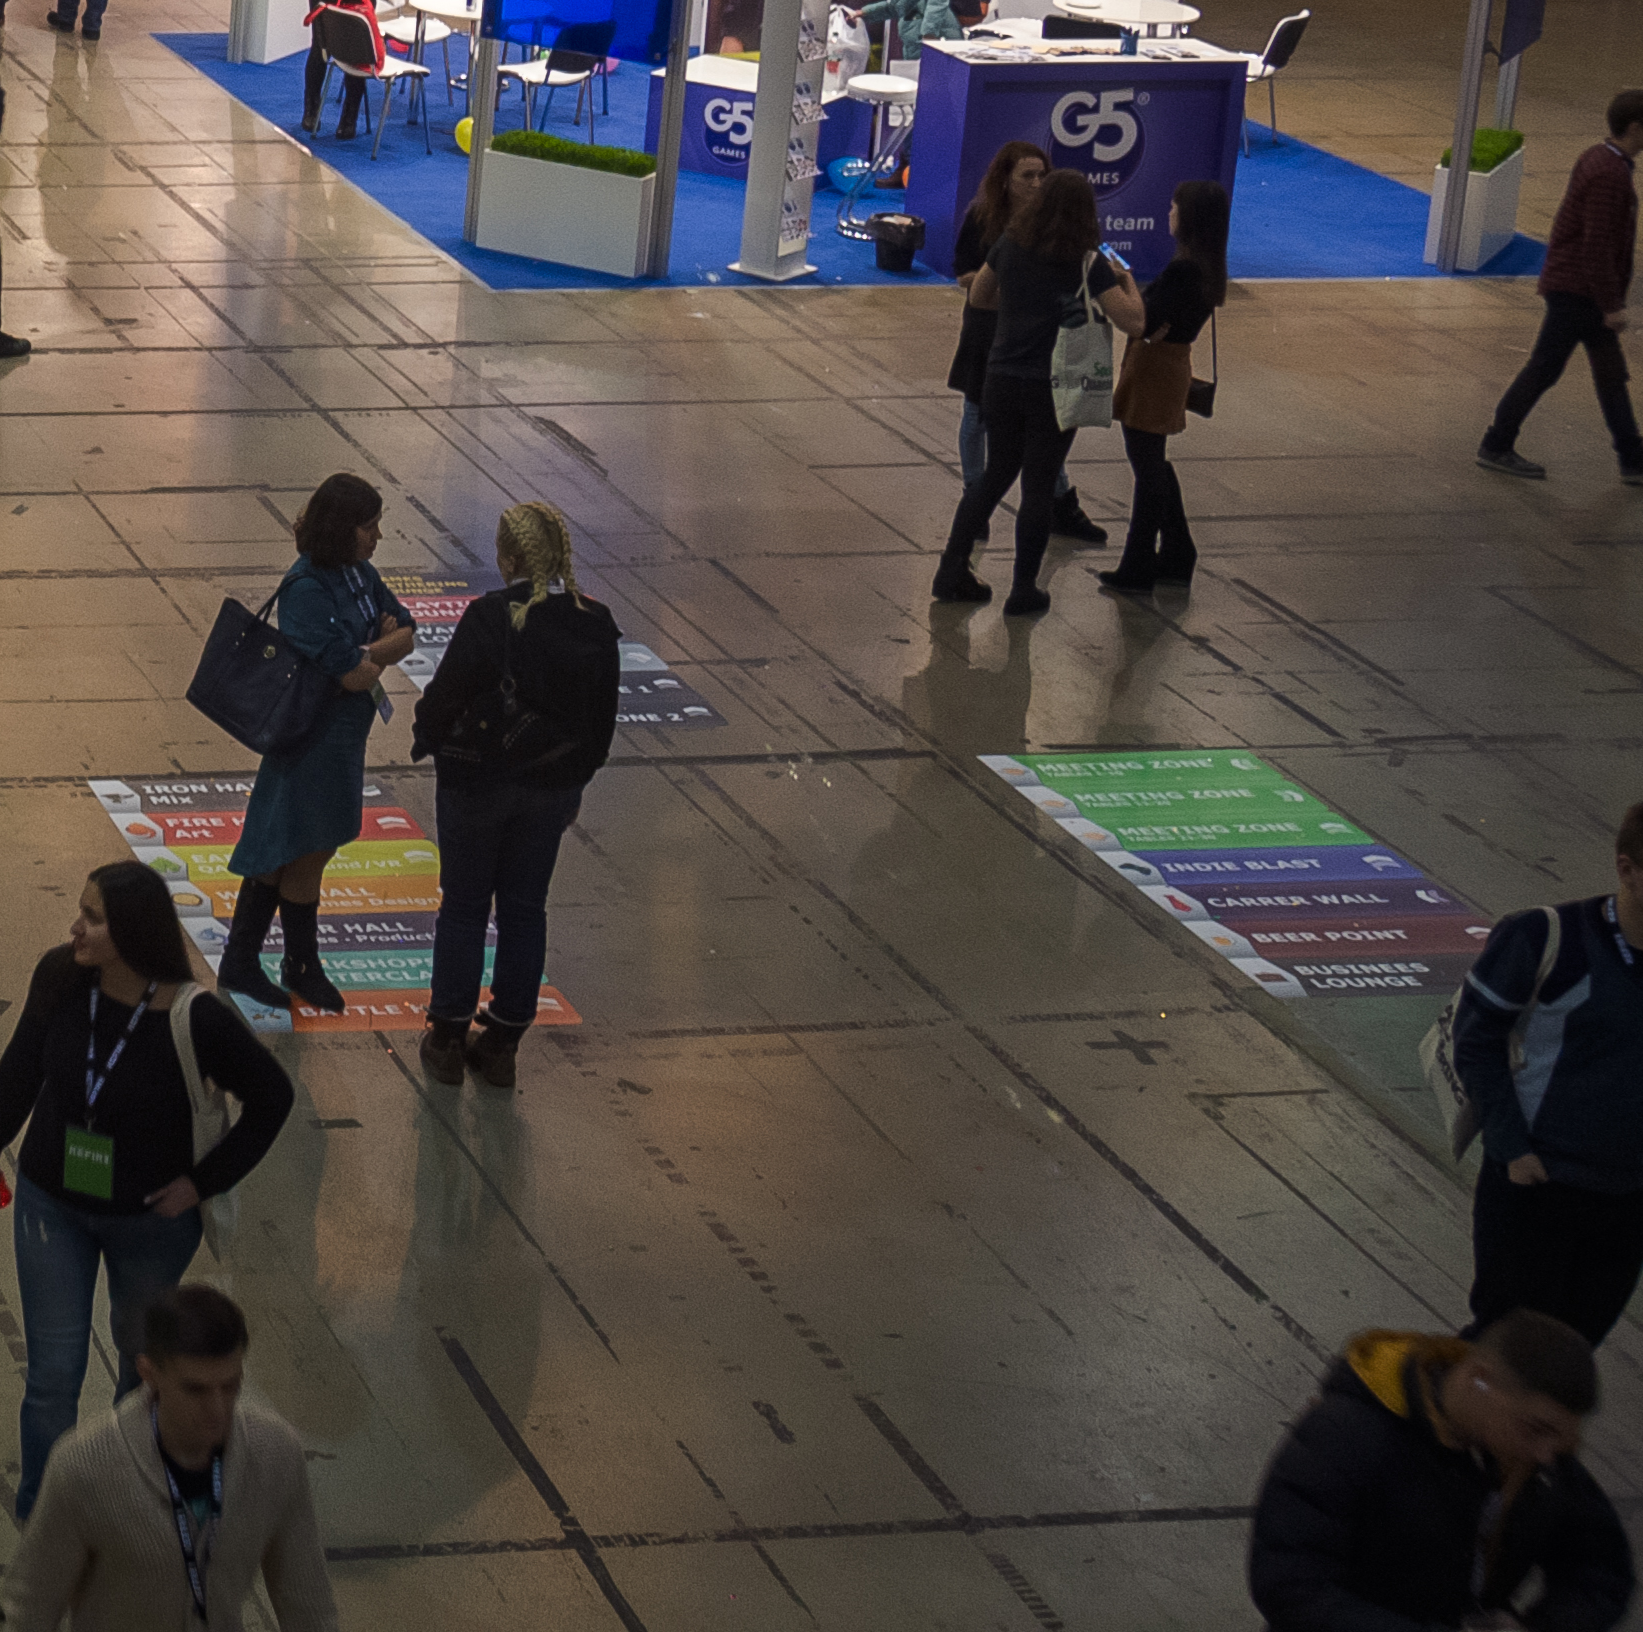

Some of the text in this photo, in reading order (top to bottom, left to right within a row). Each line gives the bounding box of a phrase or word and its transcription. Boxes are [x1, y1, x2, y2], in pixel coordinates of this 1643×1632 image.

[704, 98, 753, 145] G5
[1051, 87, 1135, 162] G5
[713, 146, 746, 159] GAMES
[1087, 172, 1119, 185] MES
[1112, 216, 1154, 231] team
[615, 712, 685, 723] ONE 2
[1036, 758, 1215, 772] MEETING ZONE
[142, 782, 255, 794] IRON HA
[149, 795, 193, 806] Mix
[1073, 788, 1256, 802] MEETING ZONE
[166, 817, 226, 828] FIRE
[1117, 821, 1304, 836] MEETING ZONE
[175, 829, 214, 839] Art
[1163, 857, 1322, 873] INDIE BLAST
[321, 896, 440, 908] mes Design
[1312, 893, 1390, 905] WALL
[344, 921, 414, 934] HALL
[1250, 928, 1409, 944] BEER POINT
[1309, 975, 1423, 990] LOUNGE
[299, 1004, 404, 1018] BATTLE
